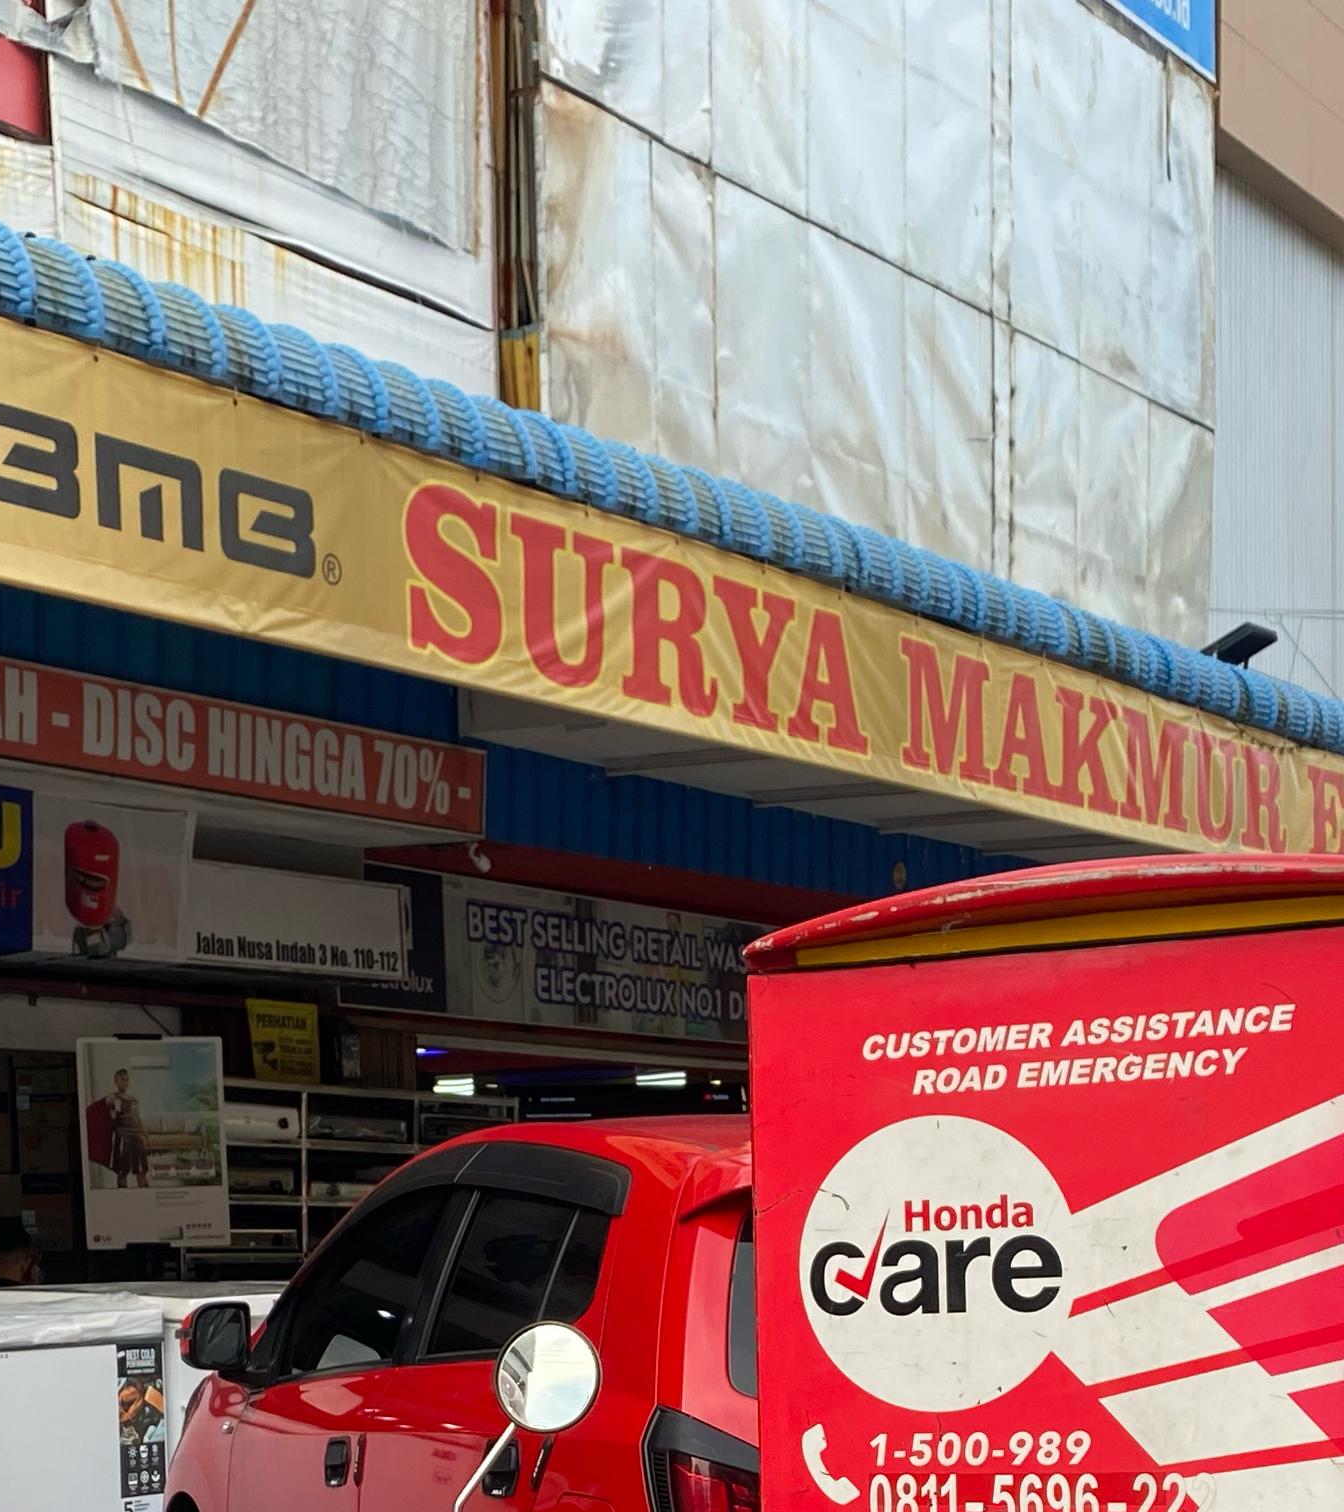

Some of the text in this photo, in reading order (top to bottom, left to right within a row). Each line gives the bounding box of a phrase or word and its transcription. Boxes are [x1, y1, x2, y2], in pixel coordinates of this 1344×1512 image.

[402, 478, 871, 760] SURYA
[900, 635, 1288, 856] MAKMUR
[82, 684, 196, 773] DISC
[207, 711, 367, 803] HINGGA
[195, 931, 399, 972] Jalan Nusa Indah 3 No. 110-112
[467, 899, 748, 976] BEST SELLING RETAIL WAS
[535, 966, 677, 1018] ELECTROLUX
[680, 986, 723, 1023] NO.1
[861, 1003, 1297, 1062] CUSTOMER ASSISTANCE
[911, 1046, 1249, 1096] ROAD EMERGENCY
[903, 1194, 1035, 1233] Honda
[809, 1234, 1064, 1317] care
[868, 1430, 1093, 1468] 1-500-989
